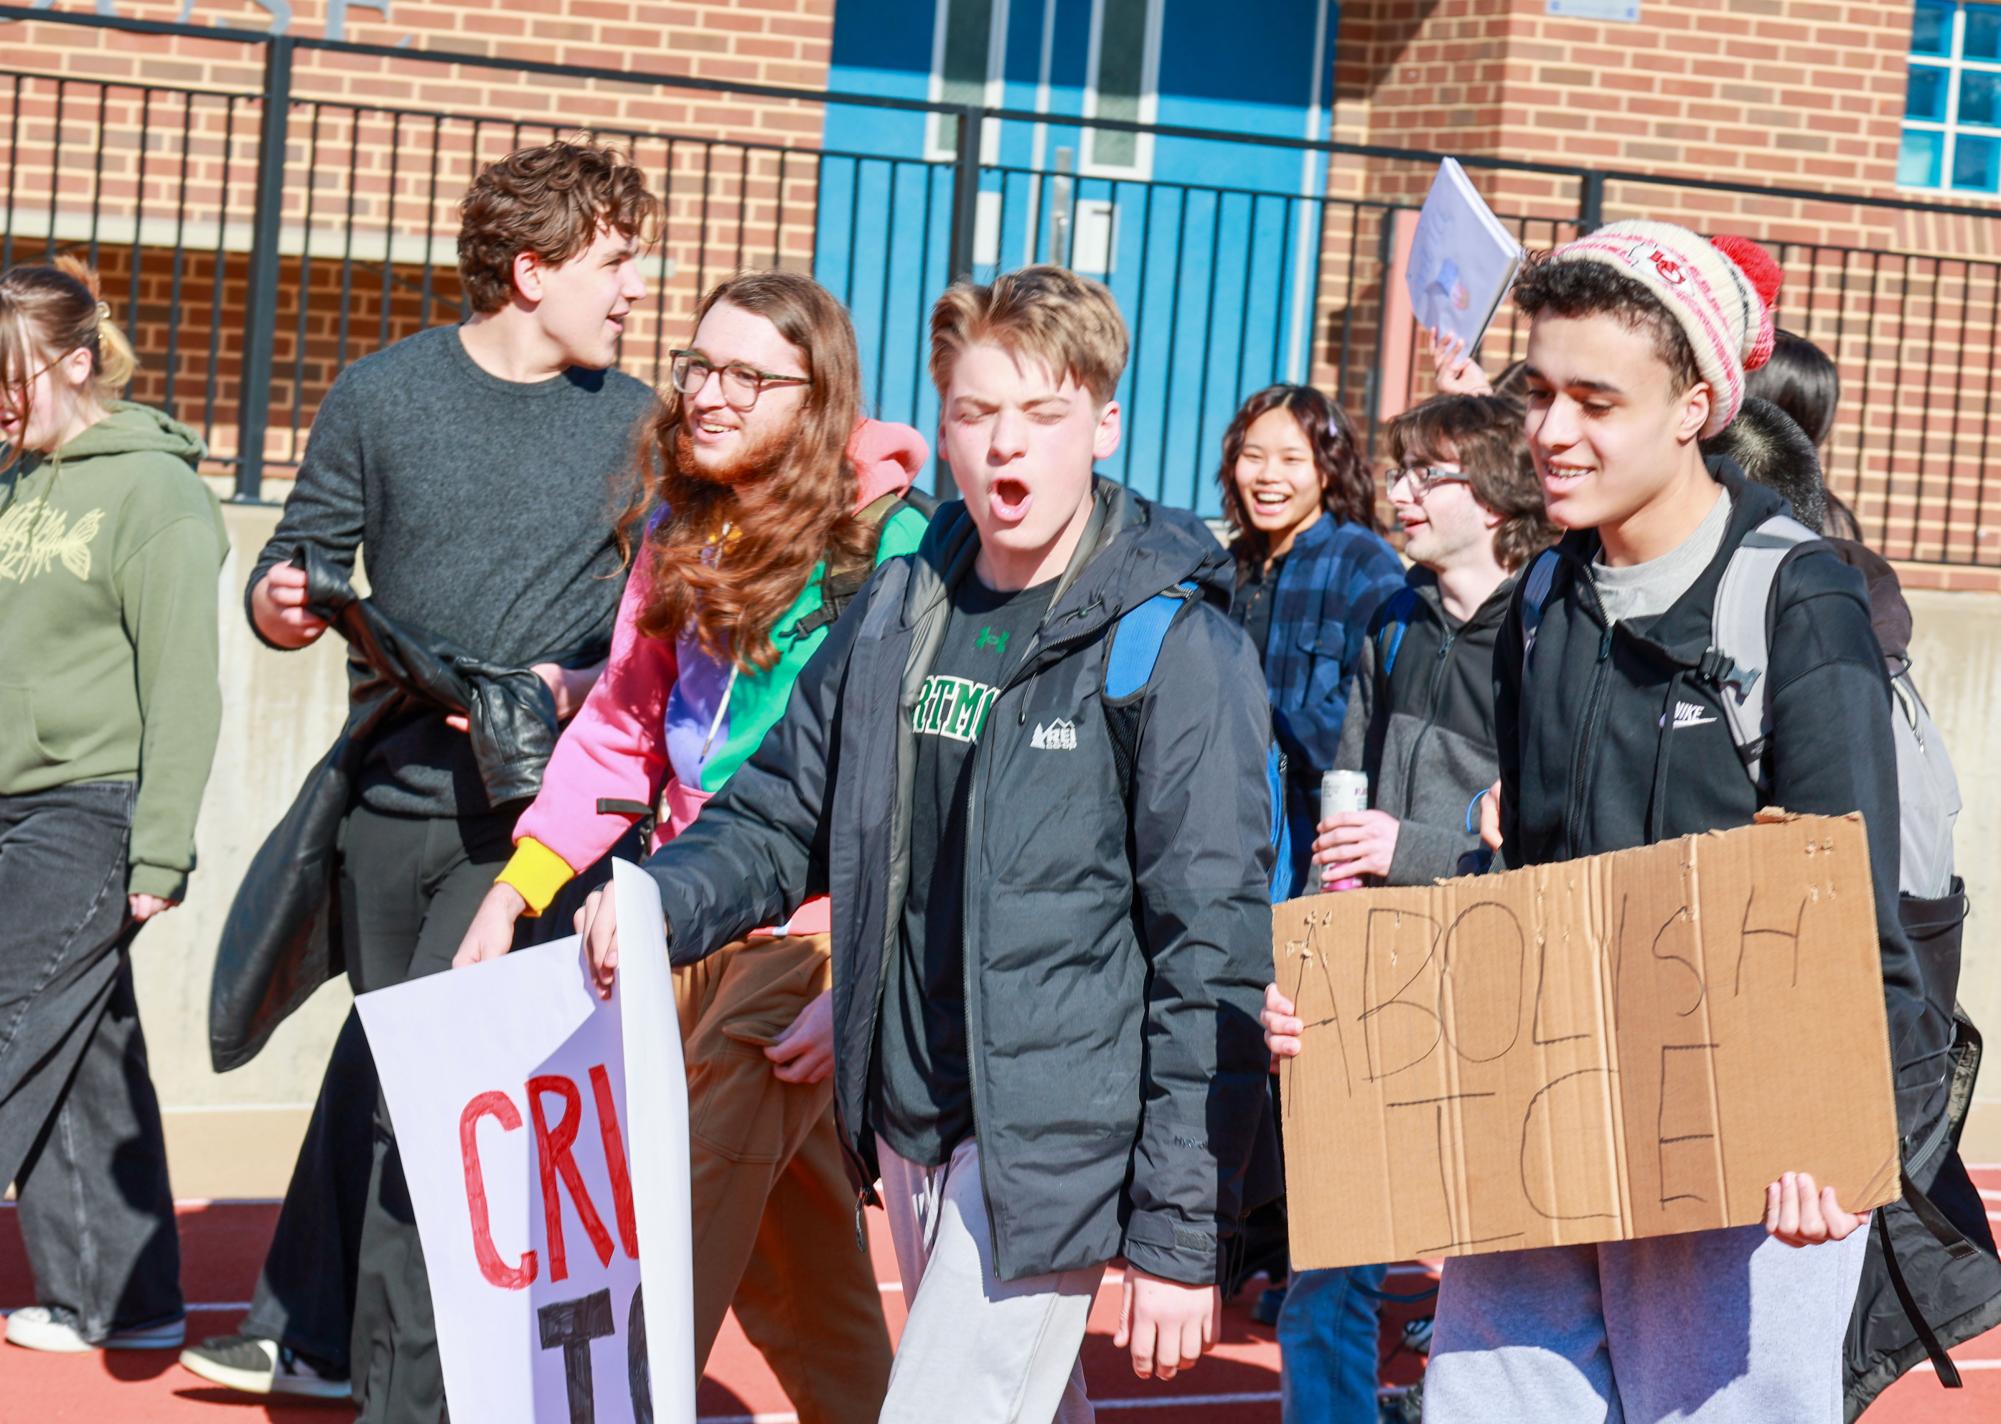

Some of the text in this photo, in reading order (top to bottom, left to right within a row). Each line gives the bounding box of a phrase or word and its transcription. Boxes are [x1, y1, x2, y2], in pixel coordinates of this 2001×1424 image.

[1287, 885, 1807, 1118] ABOLISH
[1387, 1043, 1720, 1254] ICE
[537, 1281, 654, 1424] T
